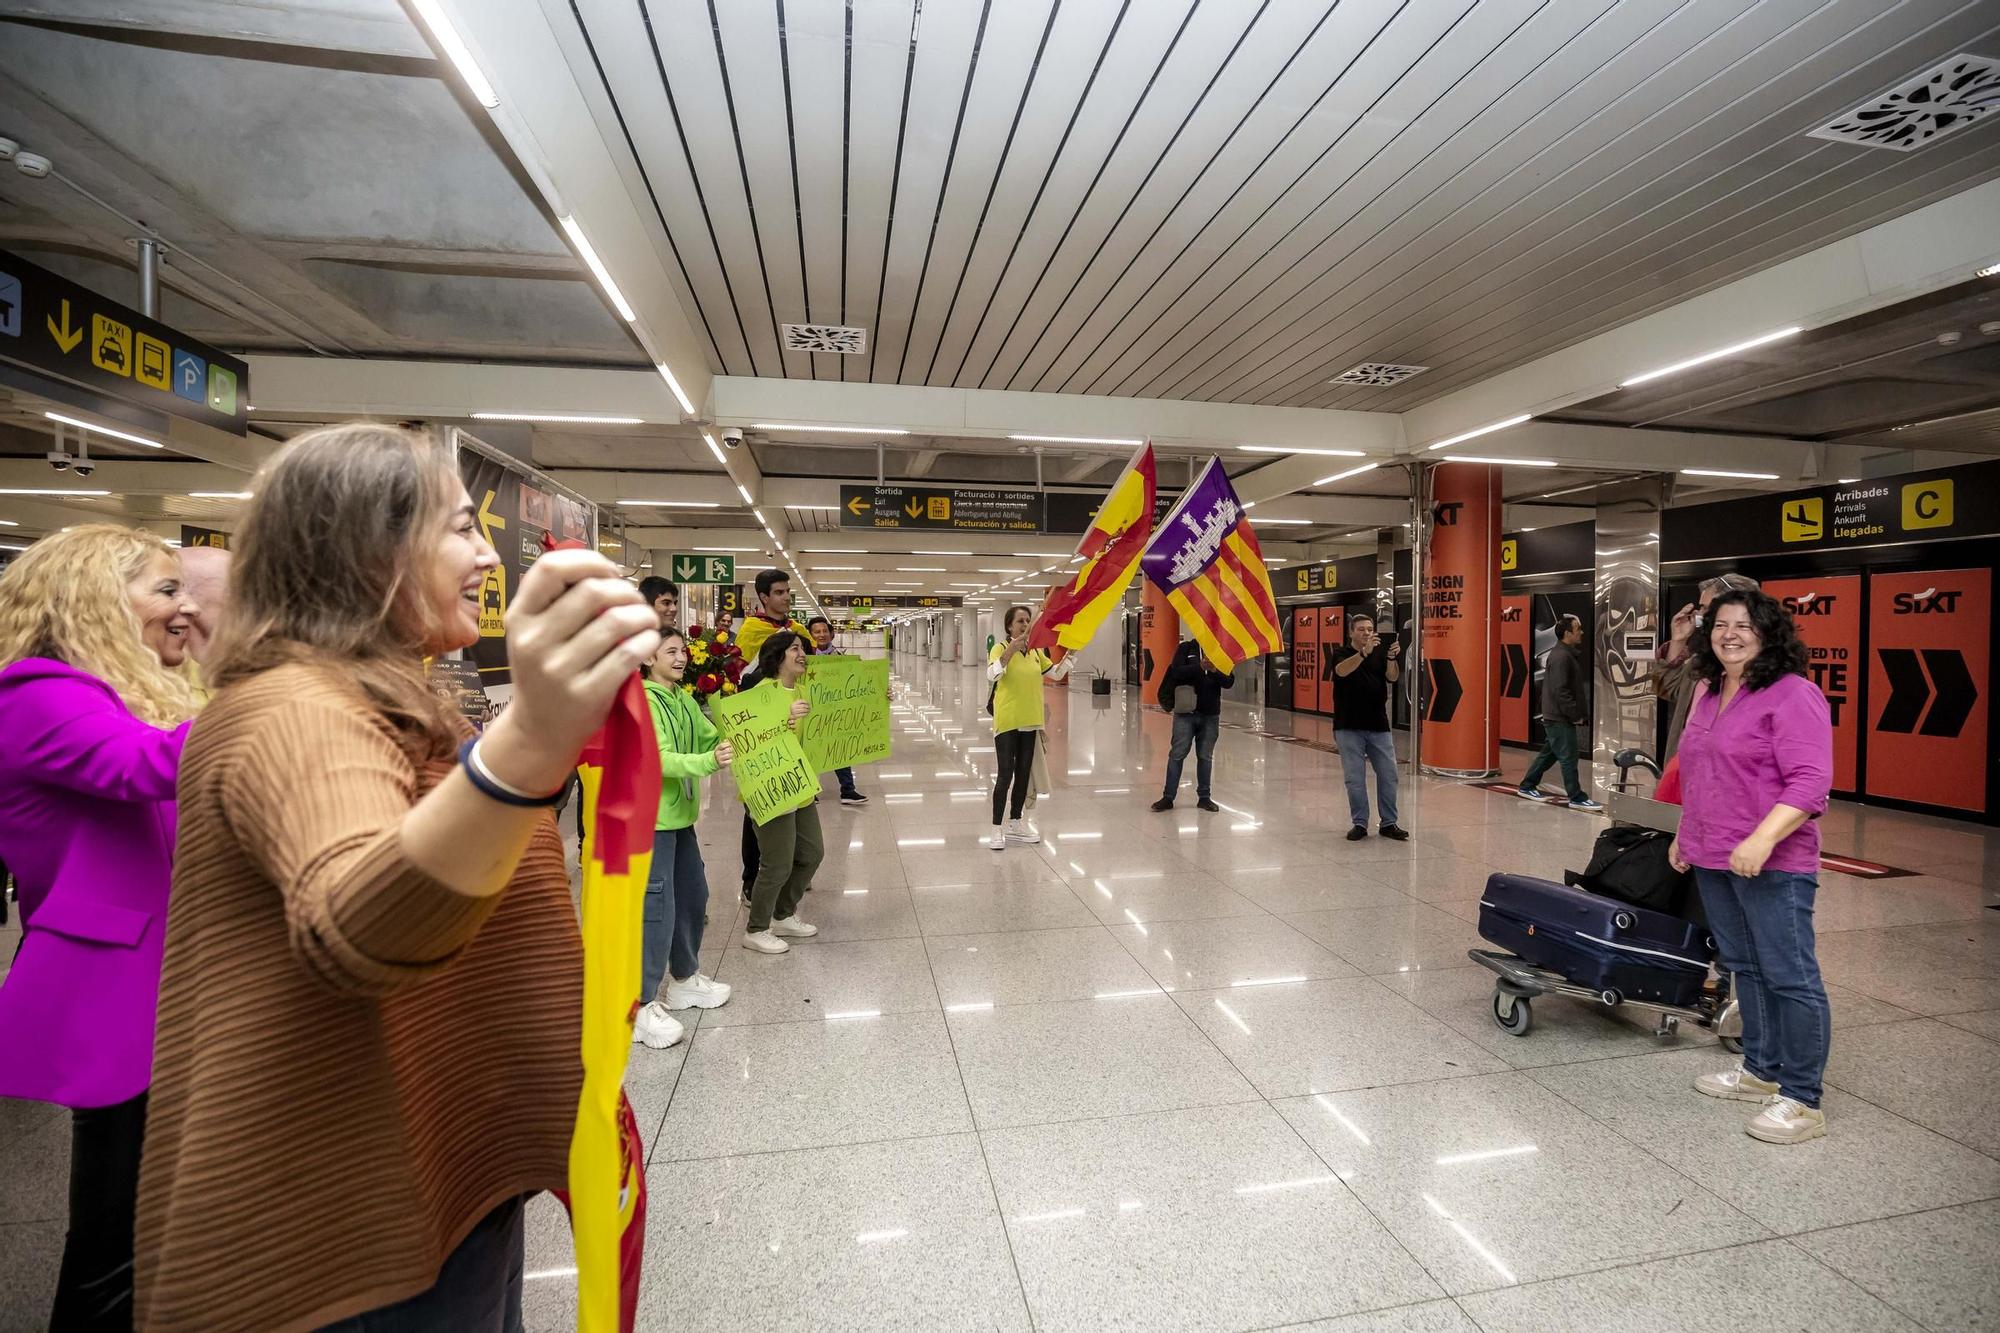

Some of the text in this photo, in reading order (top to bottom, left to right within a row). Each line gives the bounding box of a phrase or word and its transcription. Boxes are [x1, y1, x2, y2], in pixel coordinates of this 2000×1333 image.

[100, 318, 125, 338] TAXI
[184, 368, 197, 391] P
[874, 486, 903, 496] Sortida
[954, 489, 995, 499] Facturació
[1004, 491, 1036, 501] sortides
[1834, 486, 1889, 503] Arribades
[874, 497, 886, 505] Exit
[995, 502, 1028, 510] departures
[1915, 490, 1940, 520] C
[874, 508, 900, 518] Ausgang
[953, 509, 988, 519] Abfertigung
[1002, 511, 1022, 520] Abflug
[1834, 503, 1866, 514] Arrivals
[874, 518, 899, 527] Salida
[954, 519, 1000, 528] Facturación
[1008, 521, 1036, 529] salidas
[1834, 514, 1866, 525] Ankunft
[1834, 524, 1884, 539] Llegadas
[1502, 546, 1511, 564] C
[1431, 575, 1464, 589] SIGN
[723, 592, 737, 611] 3
[1430, 591, 1464, 603] GREAT
[480, 618, 489, 630] CAR
[1296, 649, 1315, 664] GATE
[1830, 647, 1848, 660] TO
[1296, 665, 1315, 680] SIXT
[730, 708, 758, 726] DEL
